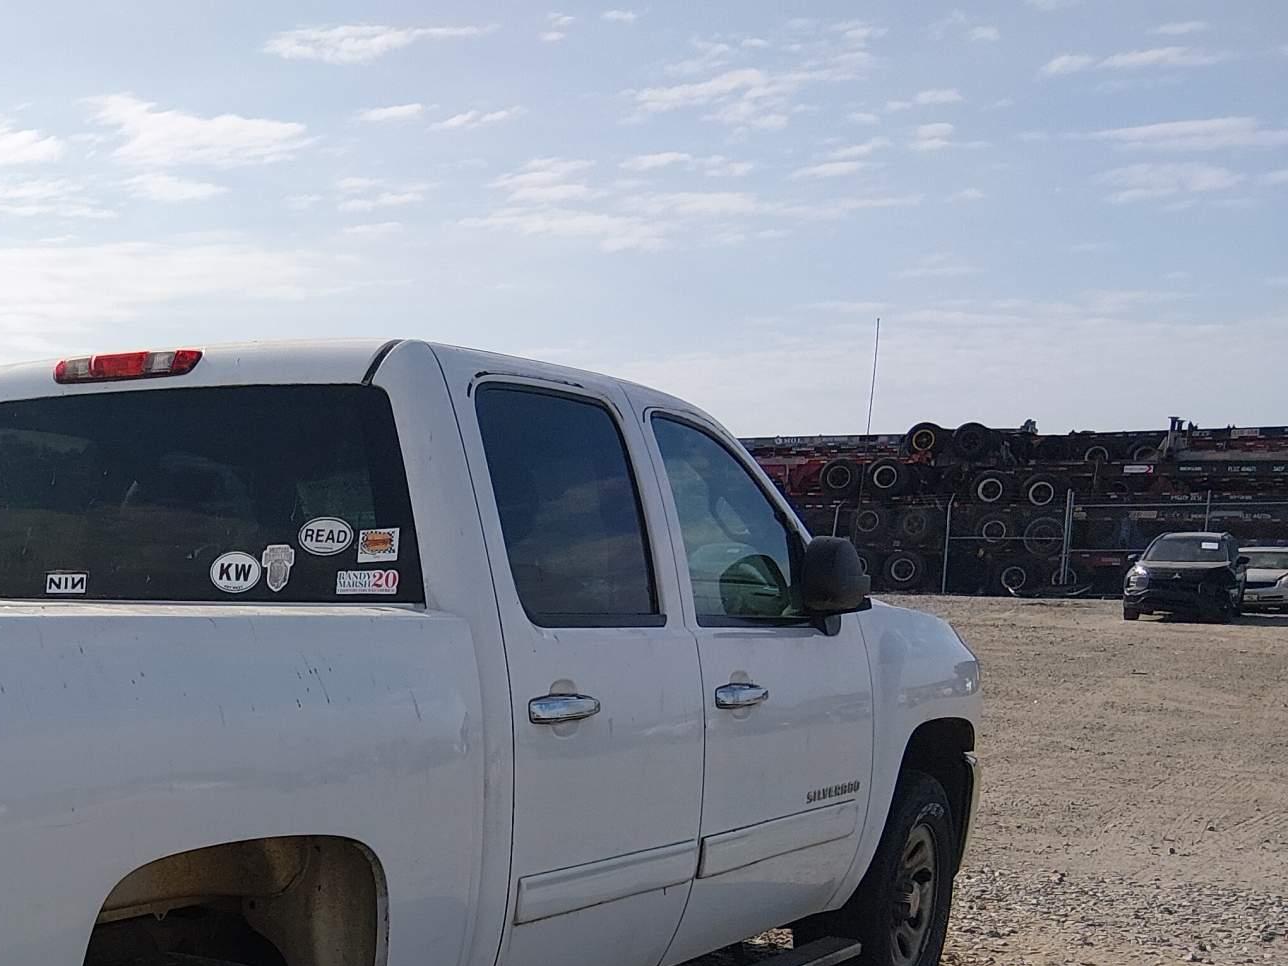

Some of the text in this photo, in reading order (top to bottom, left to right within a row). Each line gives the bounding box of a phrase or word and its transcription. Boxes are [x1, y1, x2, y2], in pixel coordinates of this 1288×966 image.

[304, 528, 348, 543] READ
[218, 562, 253, 582] KW
[338, 571, 397, 588] RANDY 20
[338, 580, 371, 588] MARSH
[806, 780, 860, 804] SILVERADO
